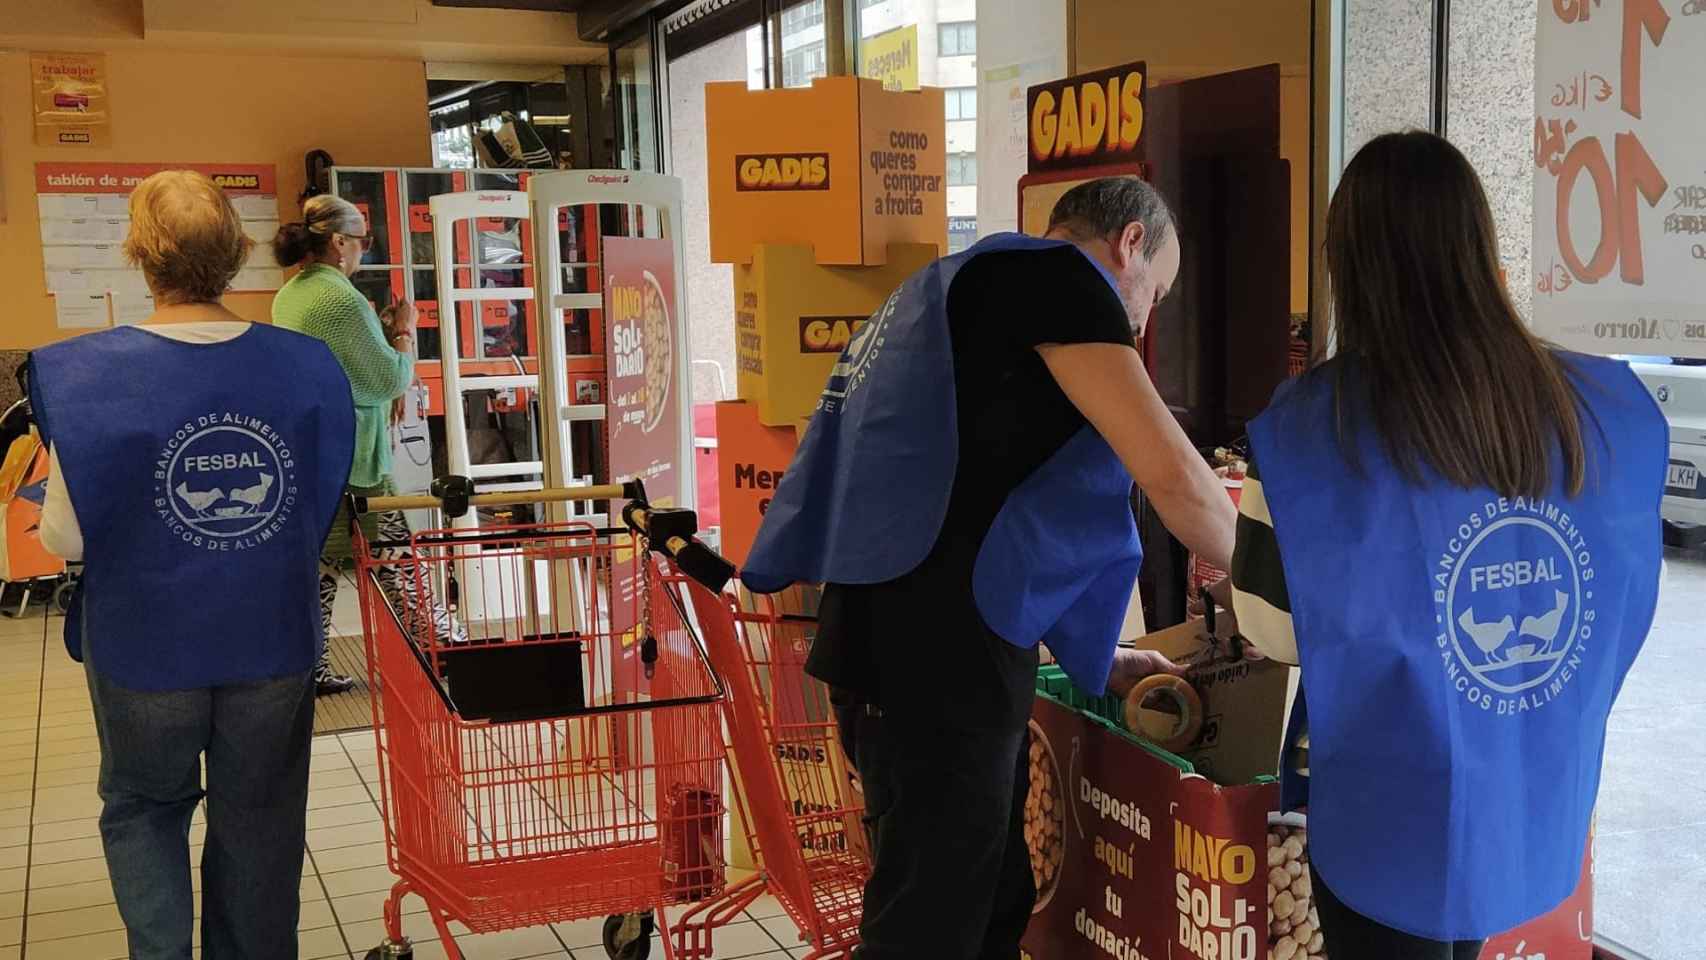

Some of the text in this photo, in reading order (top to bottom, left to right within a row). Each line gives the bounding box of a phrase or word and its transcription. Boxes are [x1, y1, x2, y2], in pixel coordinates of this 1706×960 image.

[42, 65, 97, 77] trabajar
[1031, 71, 1144, 161] GADIS
[890, 131, 928, 150] como
[739, 155, 827, 188] GADIS
[870, 151, 916, 175] queres
[47, 173, 95, 187] tablón
[100, 174, 119, 187] de
[213, 175, 258, 188] GADIS
[883, 175, 941, 196] comprar
[874, 193, 923, 216] a froita
[612, 286, 642, 321] MAYO
[804, 320, 866, 350] GA
[615, 346, 644, 378] DARIO
[154, 412, 295, 480] BANCOS DE ALIMENTOS
[184, 451, 267, 473] FESBAL
[1669, 466, 1695, 486] LKH
[154, 486, 297, 551] BANCOS DE ALIMENTOS
[1434, 495, 1595, 603] BANCOS DE ALIMENTOS
[1469, 556, 1563, 592] FESBAL
[1435, 608, 1596, 715] BANCOS DE ALIMENTOS
[1079, 776, 1151, 841] Deposita
[1094, 834, 1135, 880] aquí
[1172, 820, 1256, 885] MAYO
[1105, 885, 1123, 918] tu
[1178, 912, 1257, 960] DARIO
